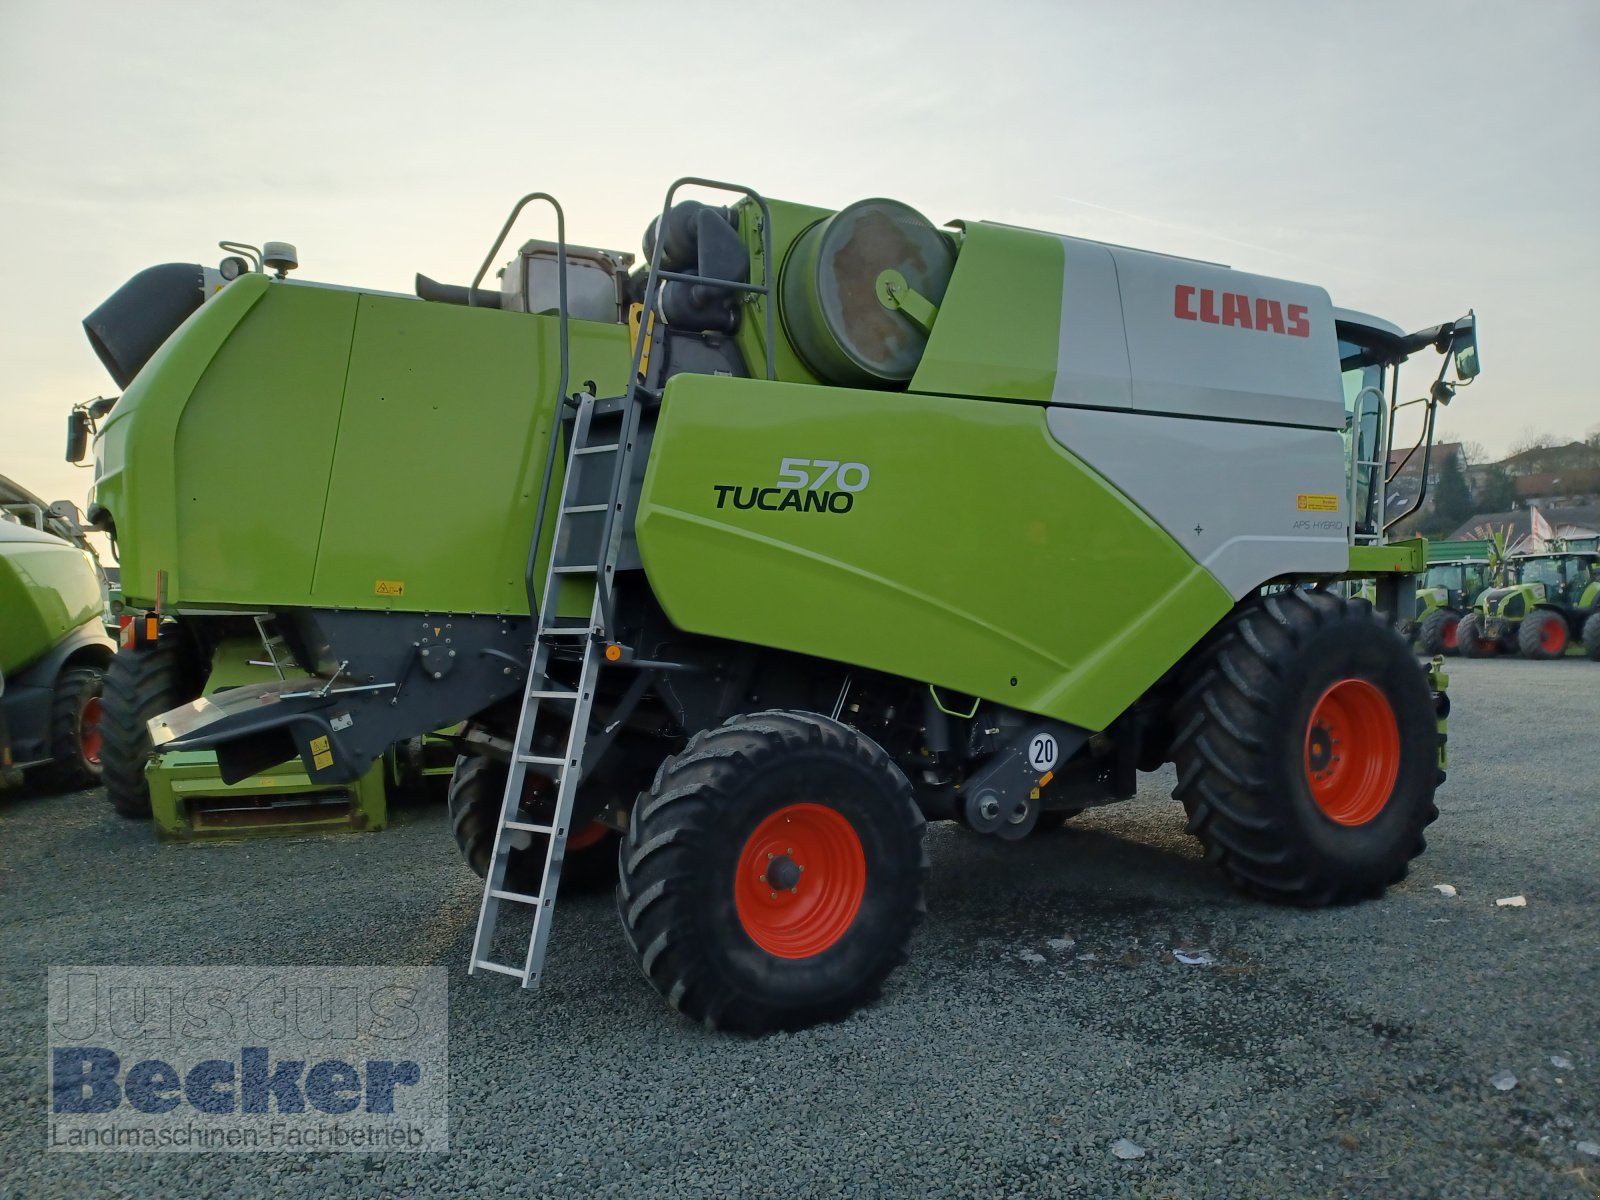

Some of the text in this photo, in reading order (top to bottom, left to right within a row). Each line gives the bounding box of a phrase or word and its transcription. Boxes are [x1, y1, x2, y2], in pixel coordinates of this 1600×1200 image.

[1174, 284, 1310, 338] CLAAS
[776, 457, 870, 492] 570
[713, 485, 854, 513] TUCANO
[1293, 520, 1342, 530] APS HYBRID
[1034, 739, 1053, 763] 20
